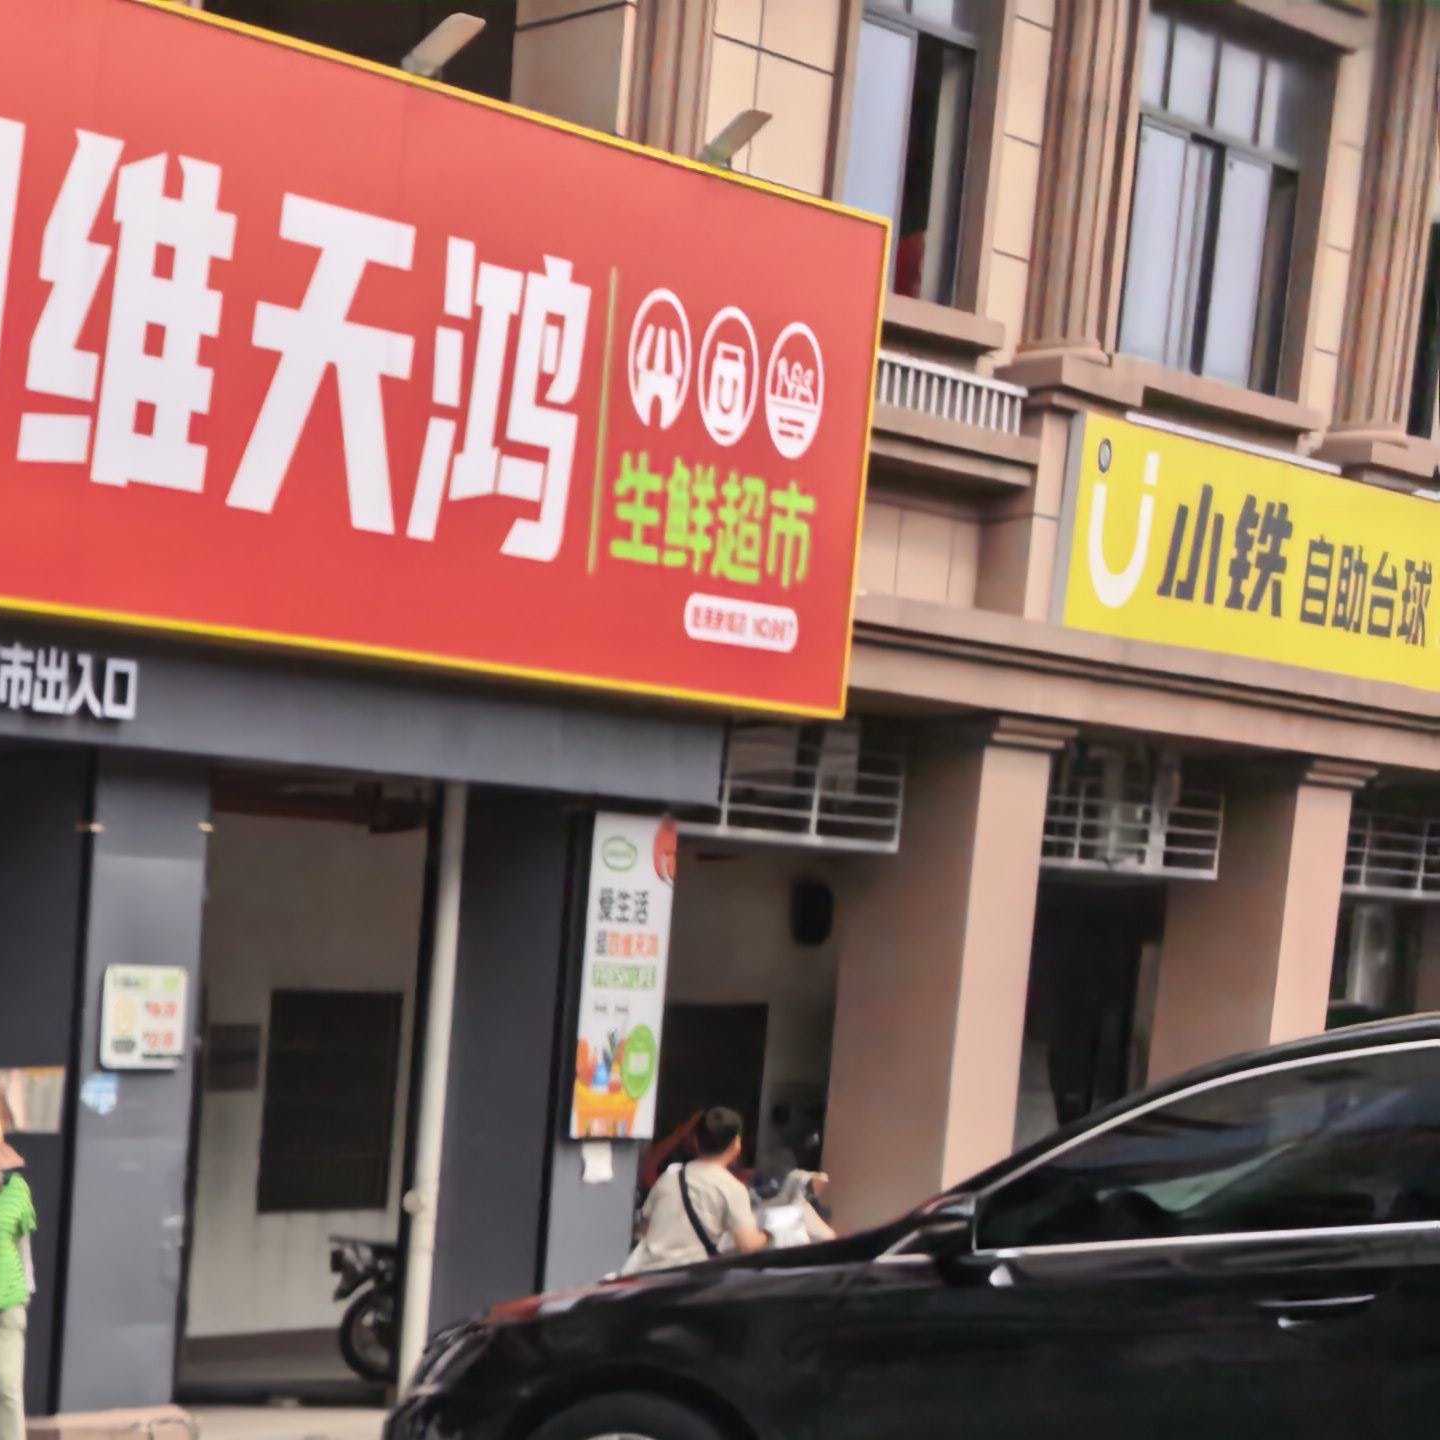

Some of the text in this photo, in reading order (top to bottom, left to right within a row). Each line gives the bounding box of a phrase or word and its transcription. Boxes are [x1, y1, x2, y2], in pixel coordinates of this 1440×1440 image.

[609, 451, 816, 588] 生鲜超市
[1157, 484, 1433, 647] 小铁 自助台球
